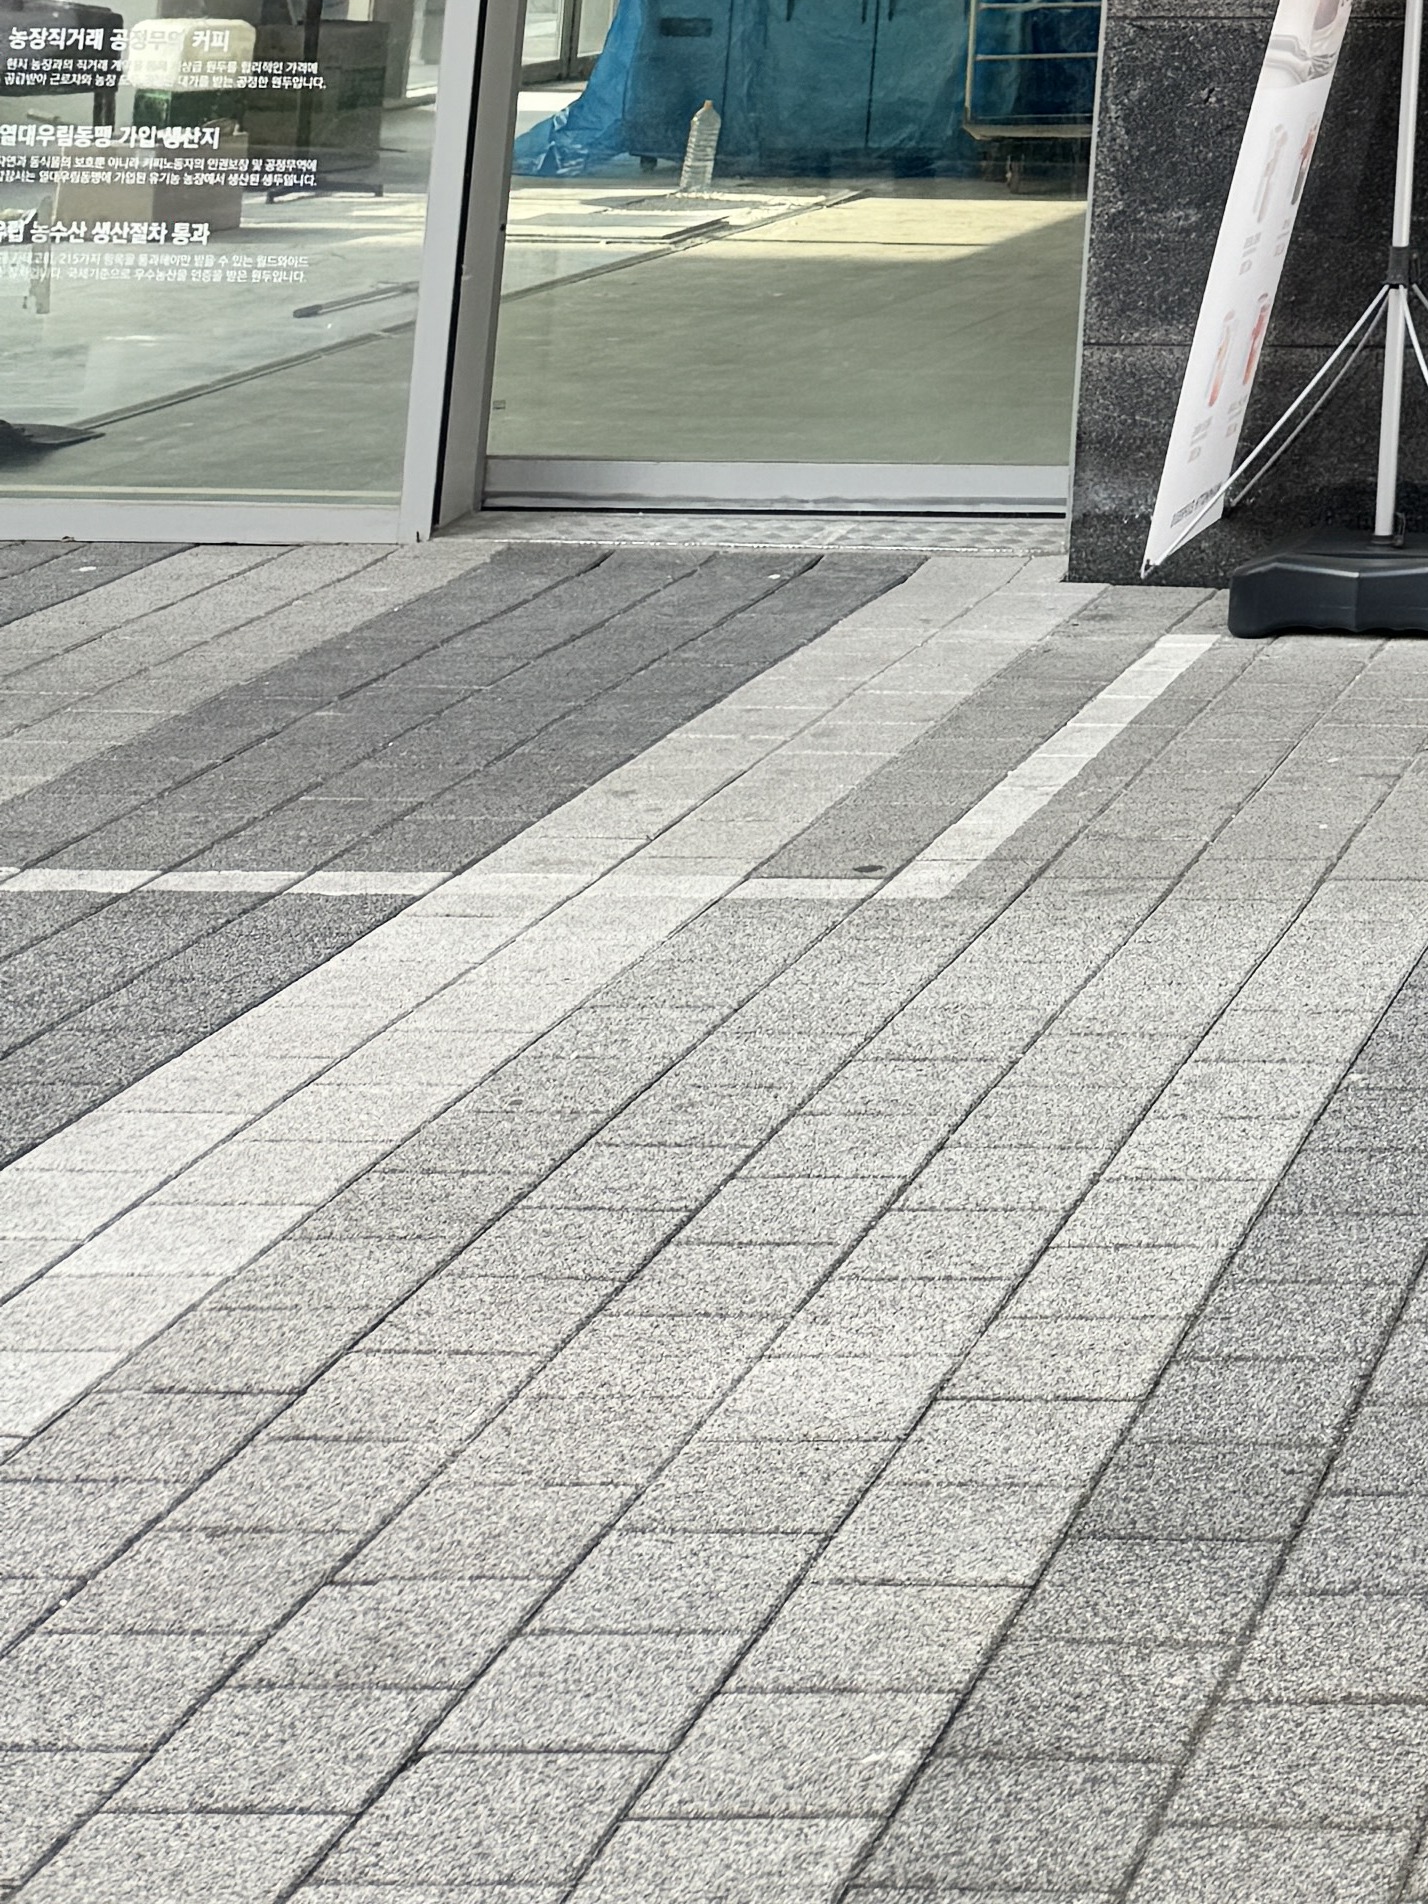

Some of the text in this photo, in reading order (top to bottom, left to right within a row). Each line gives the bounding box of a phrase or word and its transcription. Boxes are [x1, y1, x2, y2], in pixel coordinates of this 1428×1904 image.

[8, 27, 229, 52] 농장직거래 커피
[0, 125, 220, 149] 열대우림동맹 가입 생산지
[30, 221, 210, 245] 농수산 생산절차 통과
